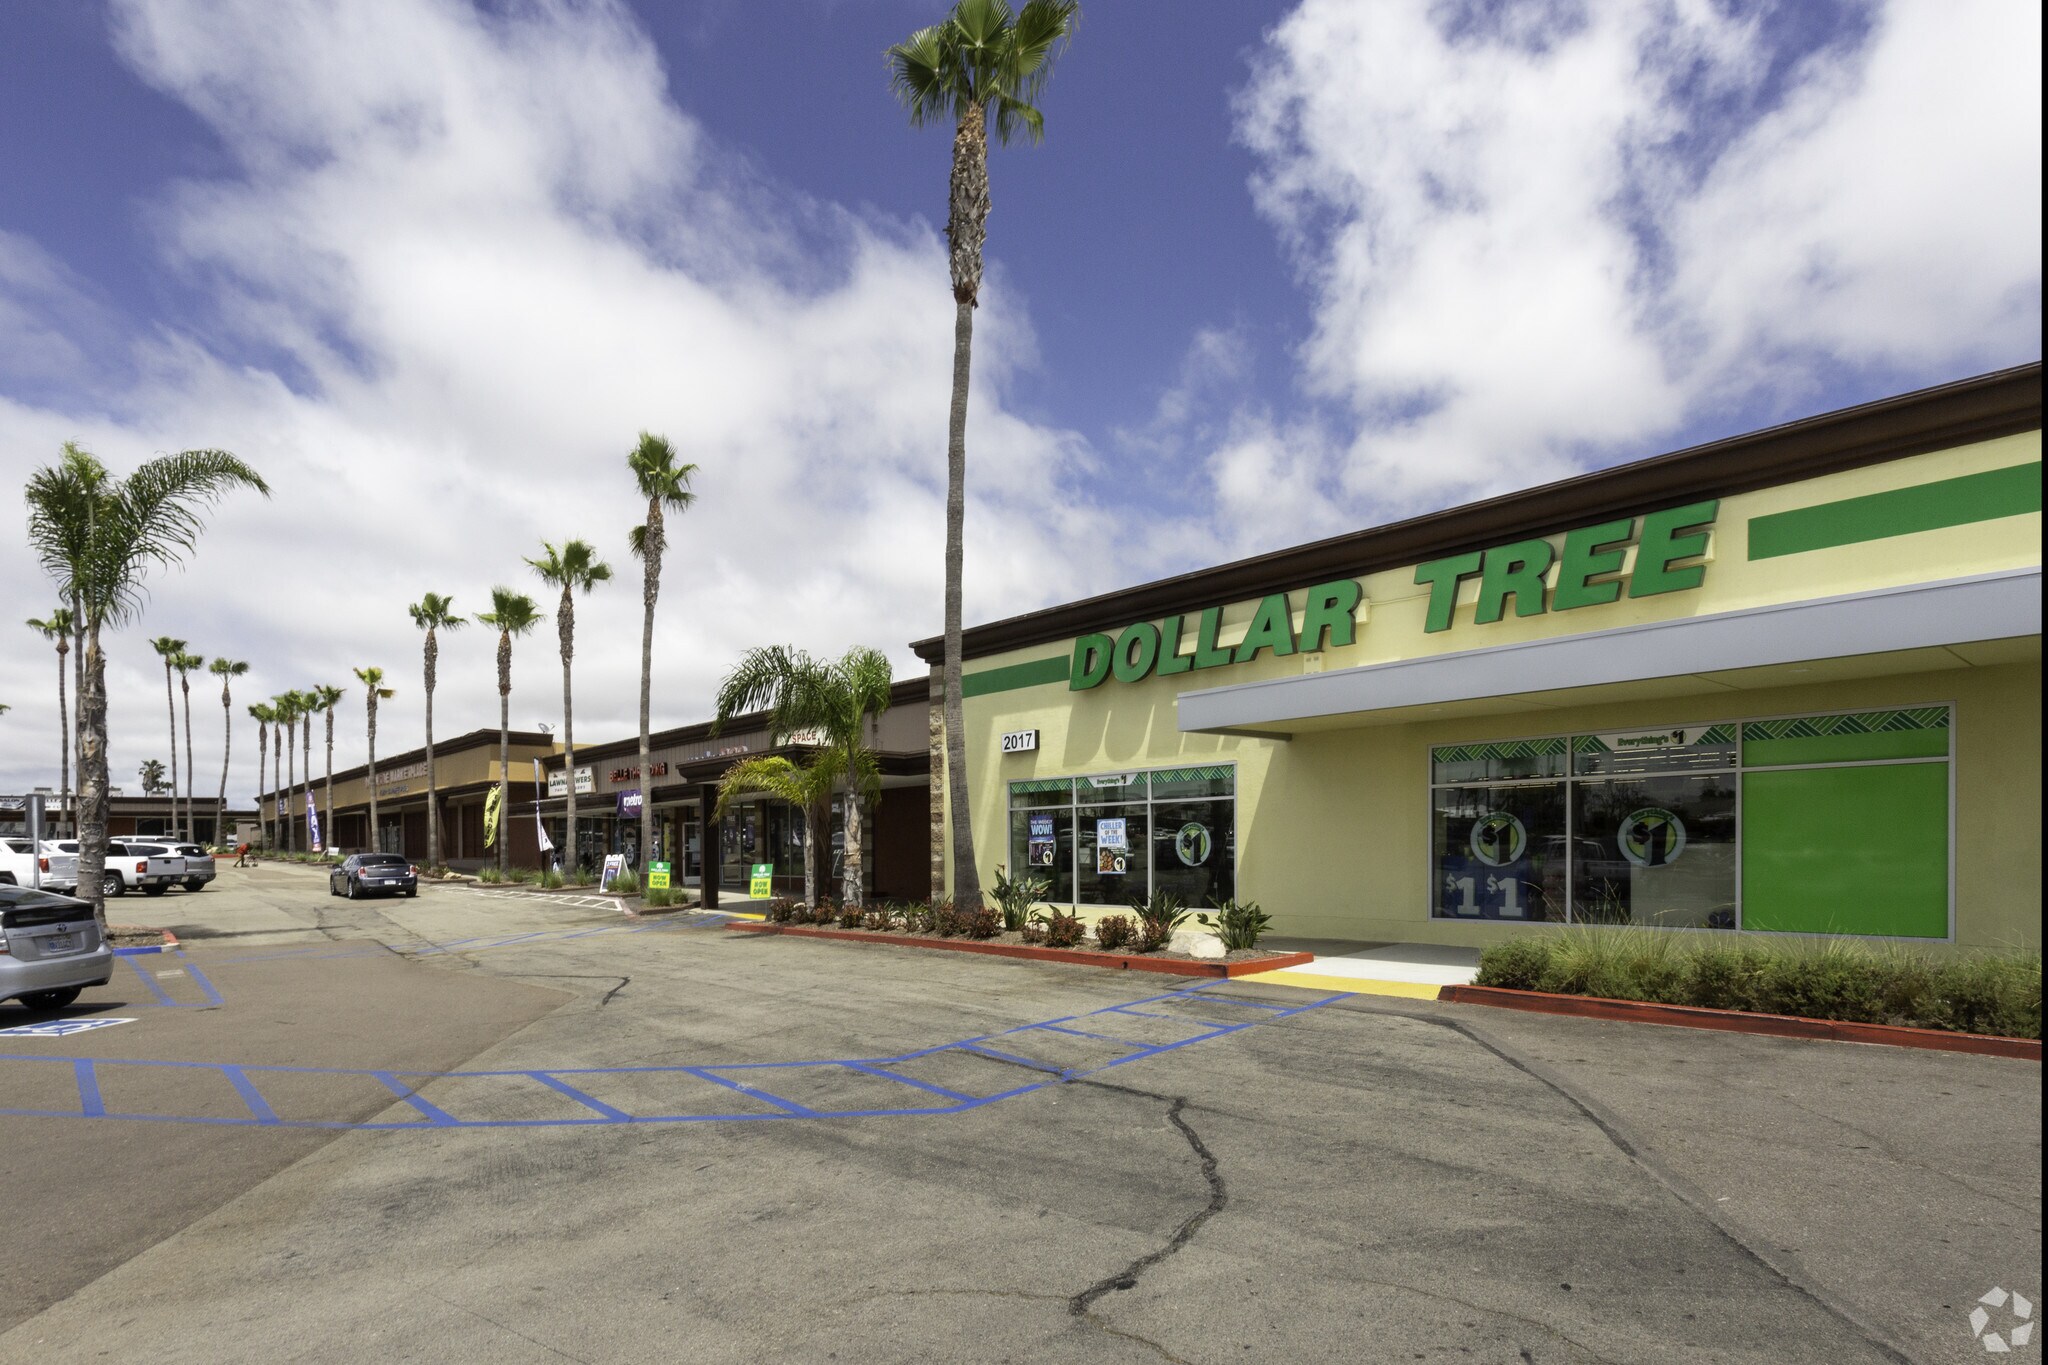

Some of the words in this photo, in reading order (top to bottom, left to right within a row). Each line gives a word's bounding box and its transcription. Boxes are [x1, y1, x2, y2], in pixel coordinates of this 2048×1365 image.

[1069, 579, 1362, 691] DOLLAR
[1414, 499, 1719, 633] TREE
[792, 731, 817, 743] SPACE
[1004, 732, 1032, 751] 2017
[1617, 735, 1669, 747] Everything's
[549, 775, 592, 787] LAWNWERS
[608, 768, 628, 783] BELLE
[623, 793, 643, 807] metro
[1030, 825, 1053, 835] WOW!
[1100, 821, 1122, 830] CHILLER
[1101, 835, 1122, 844] WEEK!
[1482, 822, 1512, 864] $1
[1632, 820, 1667, 866] $1
[1446, 873, 1480, 915] $1
[1487, 874, 1522, 917] $1
